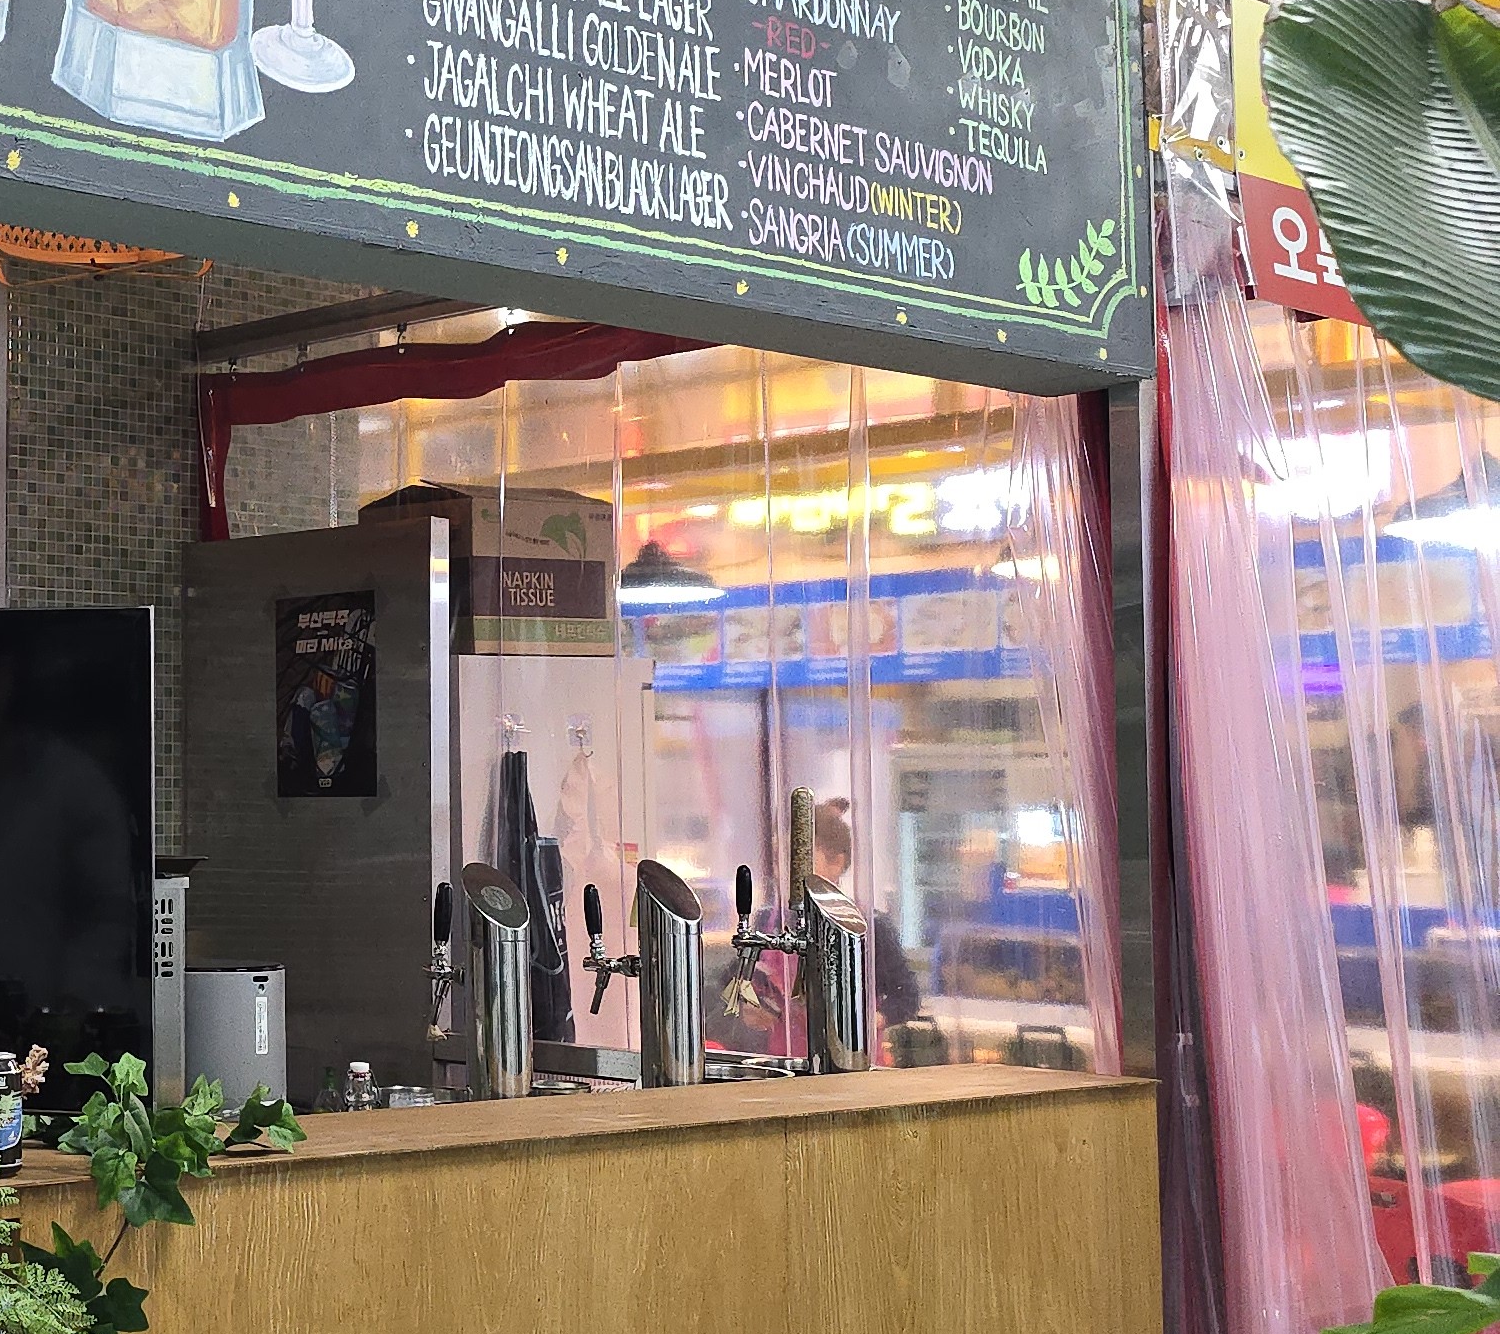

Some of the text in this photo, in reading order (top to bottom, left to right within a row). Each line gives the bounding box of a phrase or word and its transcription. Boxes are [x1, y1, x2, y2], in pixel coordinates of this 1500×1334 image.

[744, 48, 838, 109] MERLOT
[958, 40, 1026, 88] VODKA
[424, 40, 707, 160] JAGALCHI WHEAT ALE
[958, 86, 1035, 132] WHISKY
[747, 101, 994, 196] CABERNET SAUVIGNON
[959, 118, 1049, 176] TEQUILA
[503, 571, 555, 590] NAPKIN
[508, 588, 556, 607] TISSUE
